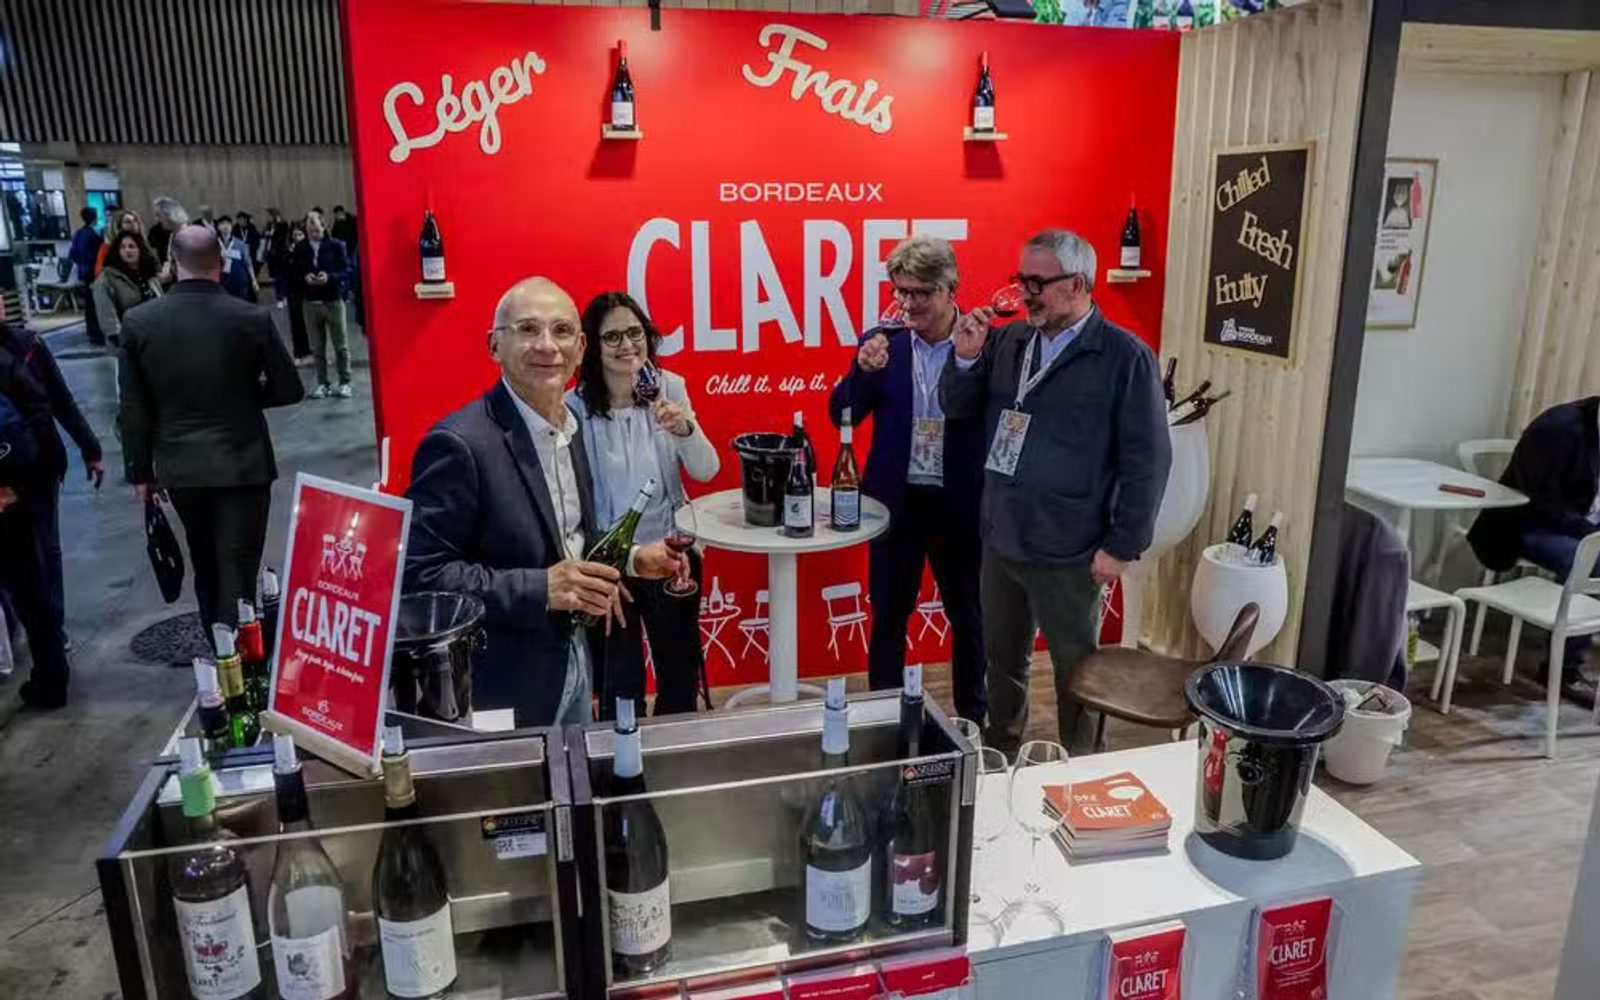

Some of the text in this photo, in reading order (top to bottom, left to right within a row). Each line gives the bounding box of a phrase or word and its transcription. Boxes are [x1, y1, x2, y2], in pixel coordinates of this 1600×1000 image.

[742, 24, 894, 134] Frais
[383, 51, 547, 163] Léger
[719, 182, 882, 202] BORDEAUX
[1216, 156, 1271, 211] Chilled
[1237, 211, 1293, 269] Fresh
[1215, 272, 1268, 308] Fruity
[705, 374, 751, 395] Chill
[778, 375, 805, 396] sip
[291, 587, 381, 667] CLARET
[1082, 804, 1132, 819] CLARET
[1271, 937, 1316, 965] CLARET
[1120, 969, 1169, 998] CLARET
